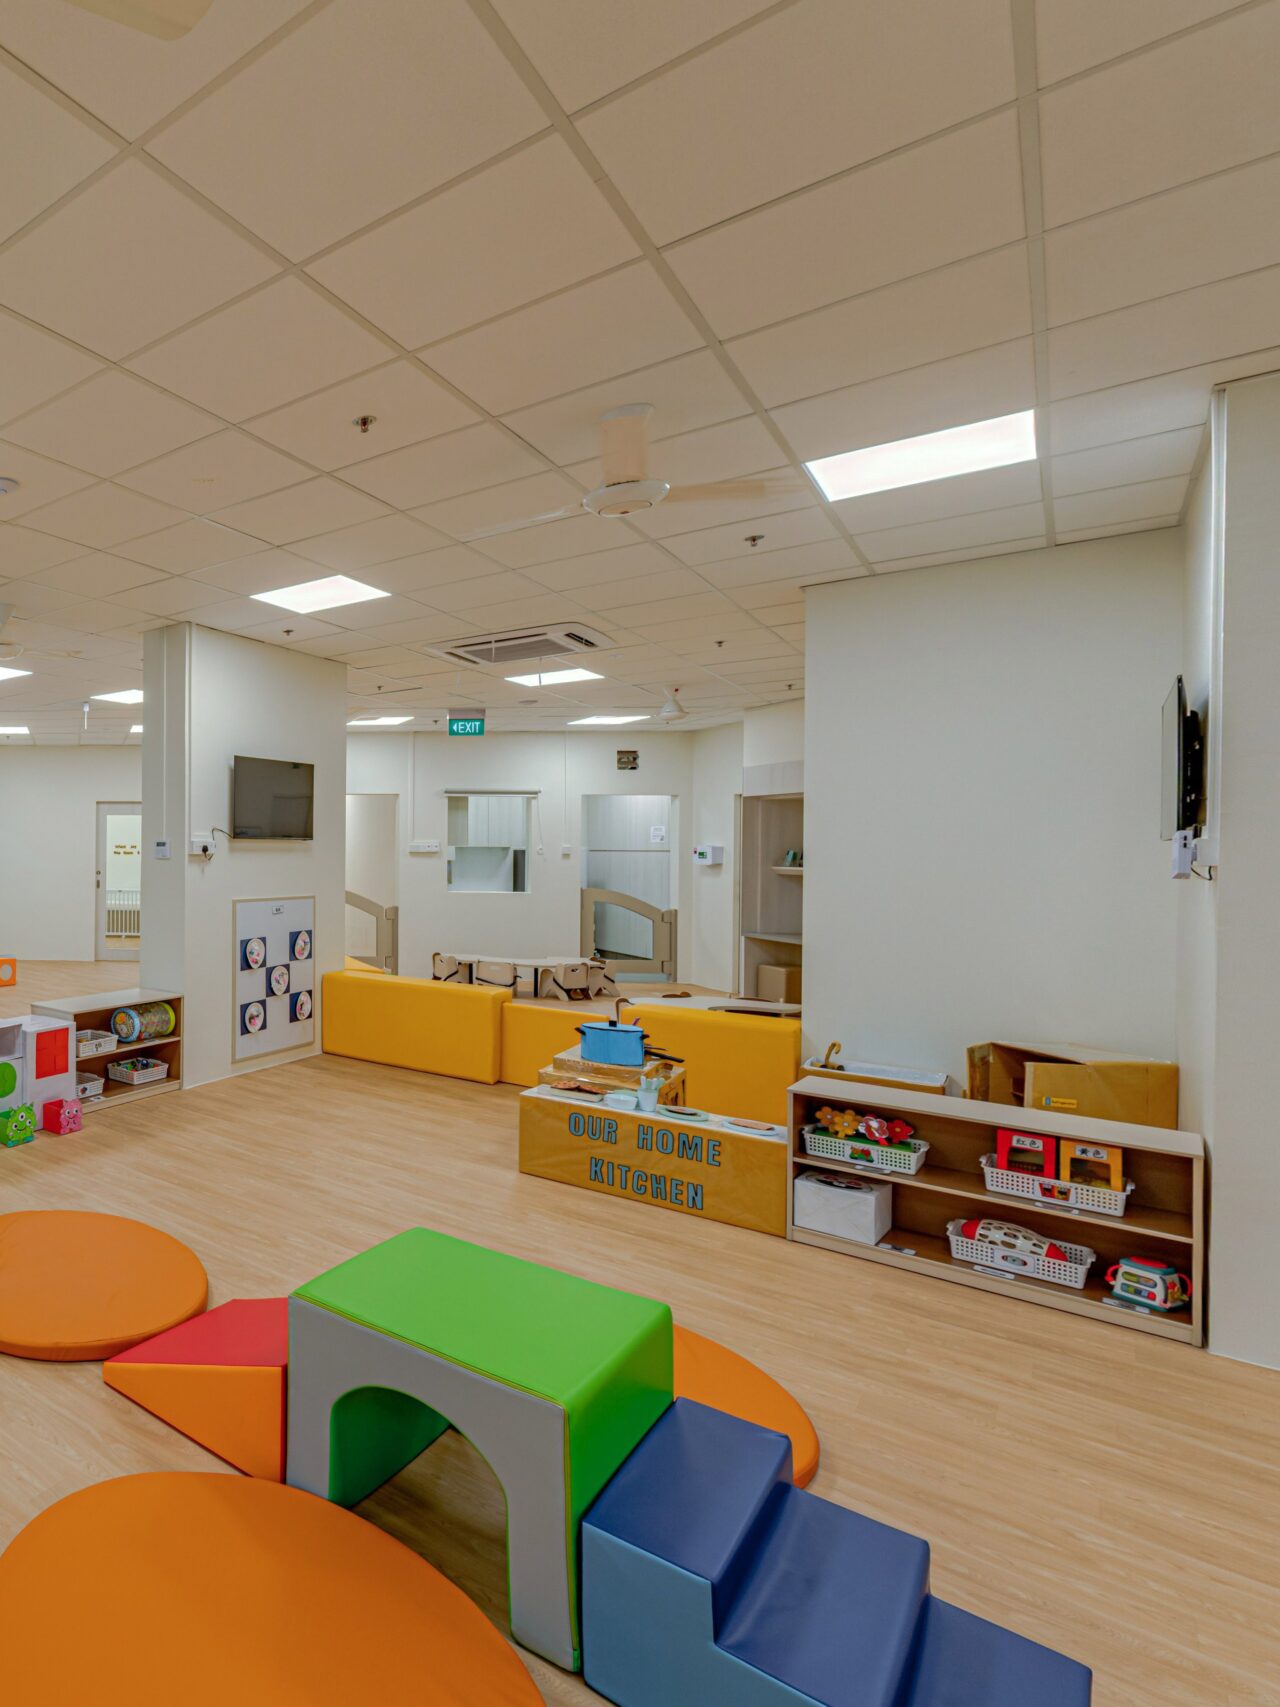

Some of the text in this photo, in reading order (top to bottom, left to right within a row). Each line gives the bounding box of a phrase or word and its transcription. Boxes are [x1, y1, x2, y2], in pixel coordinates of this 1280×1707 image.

[458, 721, 481, 733] EXIT
[568, 1112, 722, 1167] OUR HOME
[589, 1156, 704, 1210] KITCHEN
